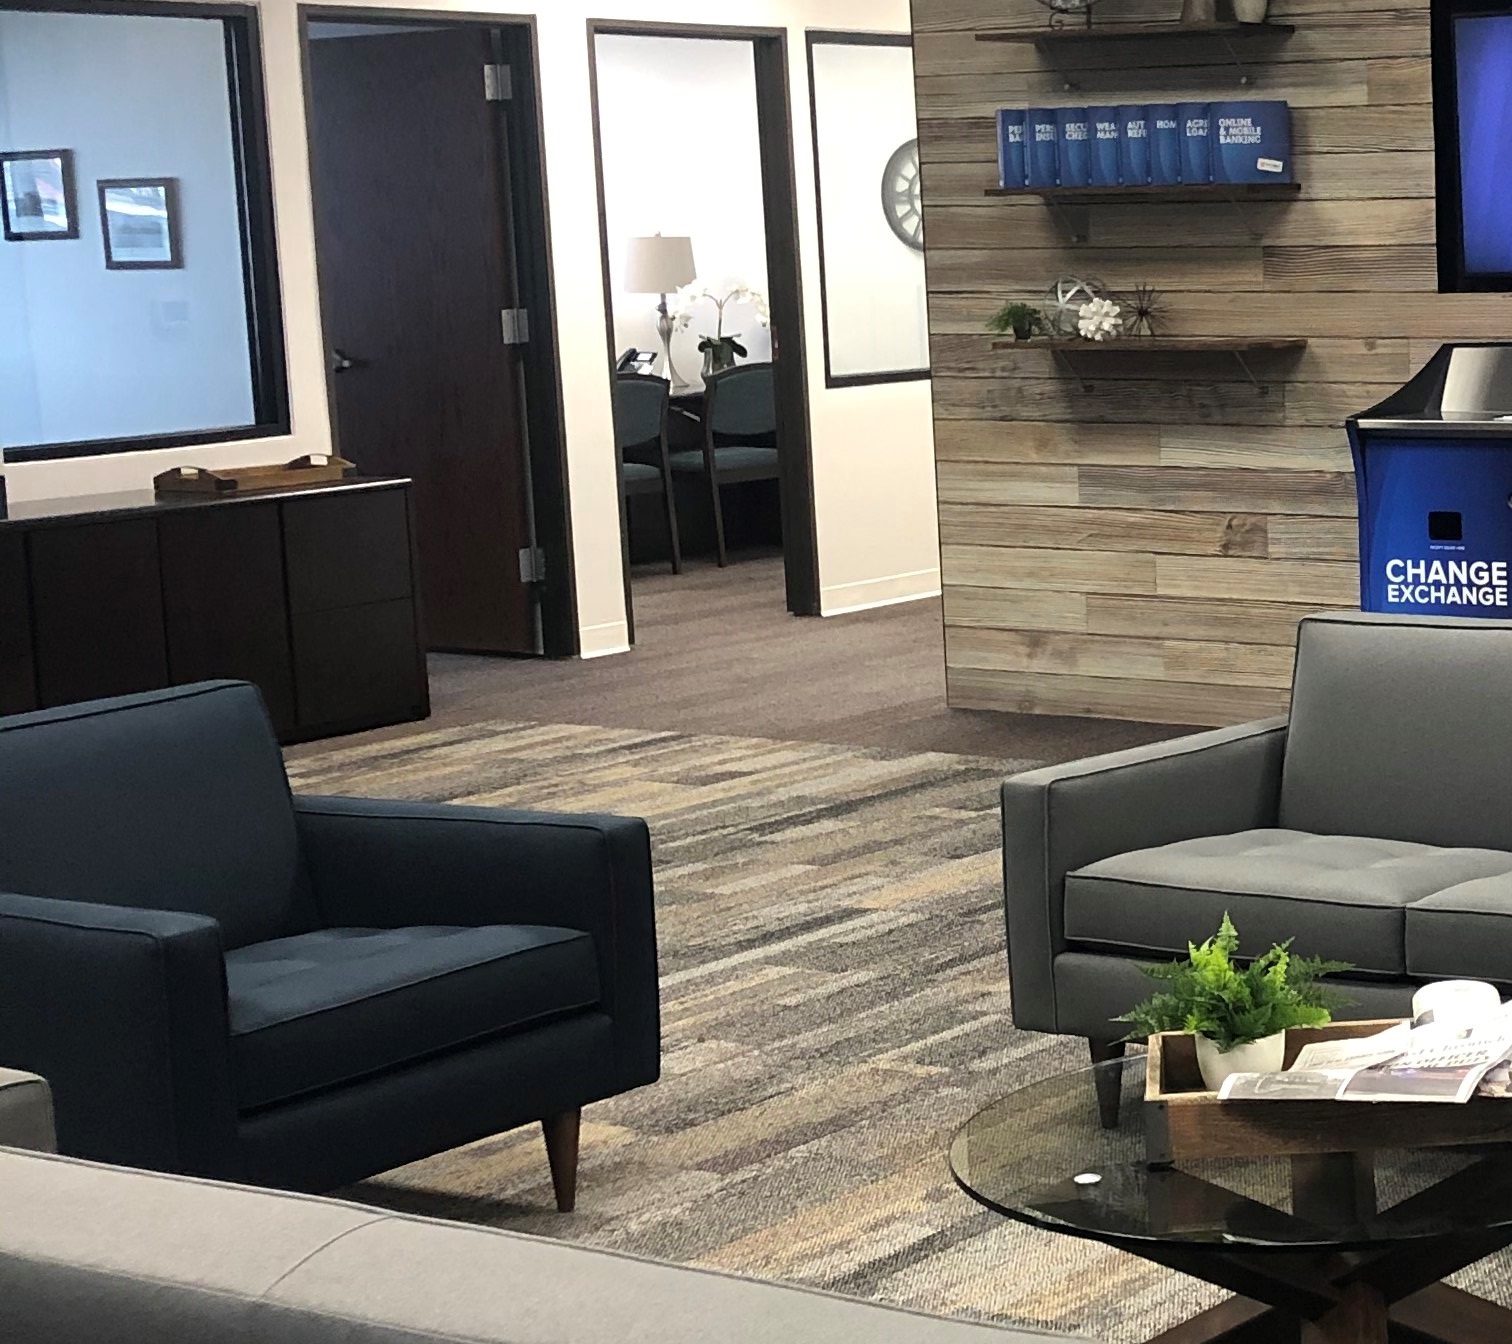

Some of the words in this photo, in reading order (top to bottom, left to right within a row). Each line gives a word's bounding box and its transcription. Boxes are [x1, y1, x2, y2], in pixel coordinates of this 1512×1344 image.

[1218, 118, 1252, 127] ONLINE
[1219, 127, 1226, 135] &
[1228, 126, 1262, 136] MOBILE
[1219, 135, 1262, 144] BANKING
[1385, 558, 1508, 586] CHANGE
[1387, 584, 1508, 606] EXCHANGE
